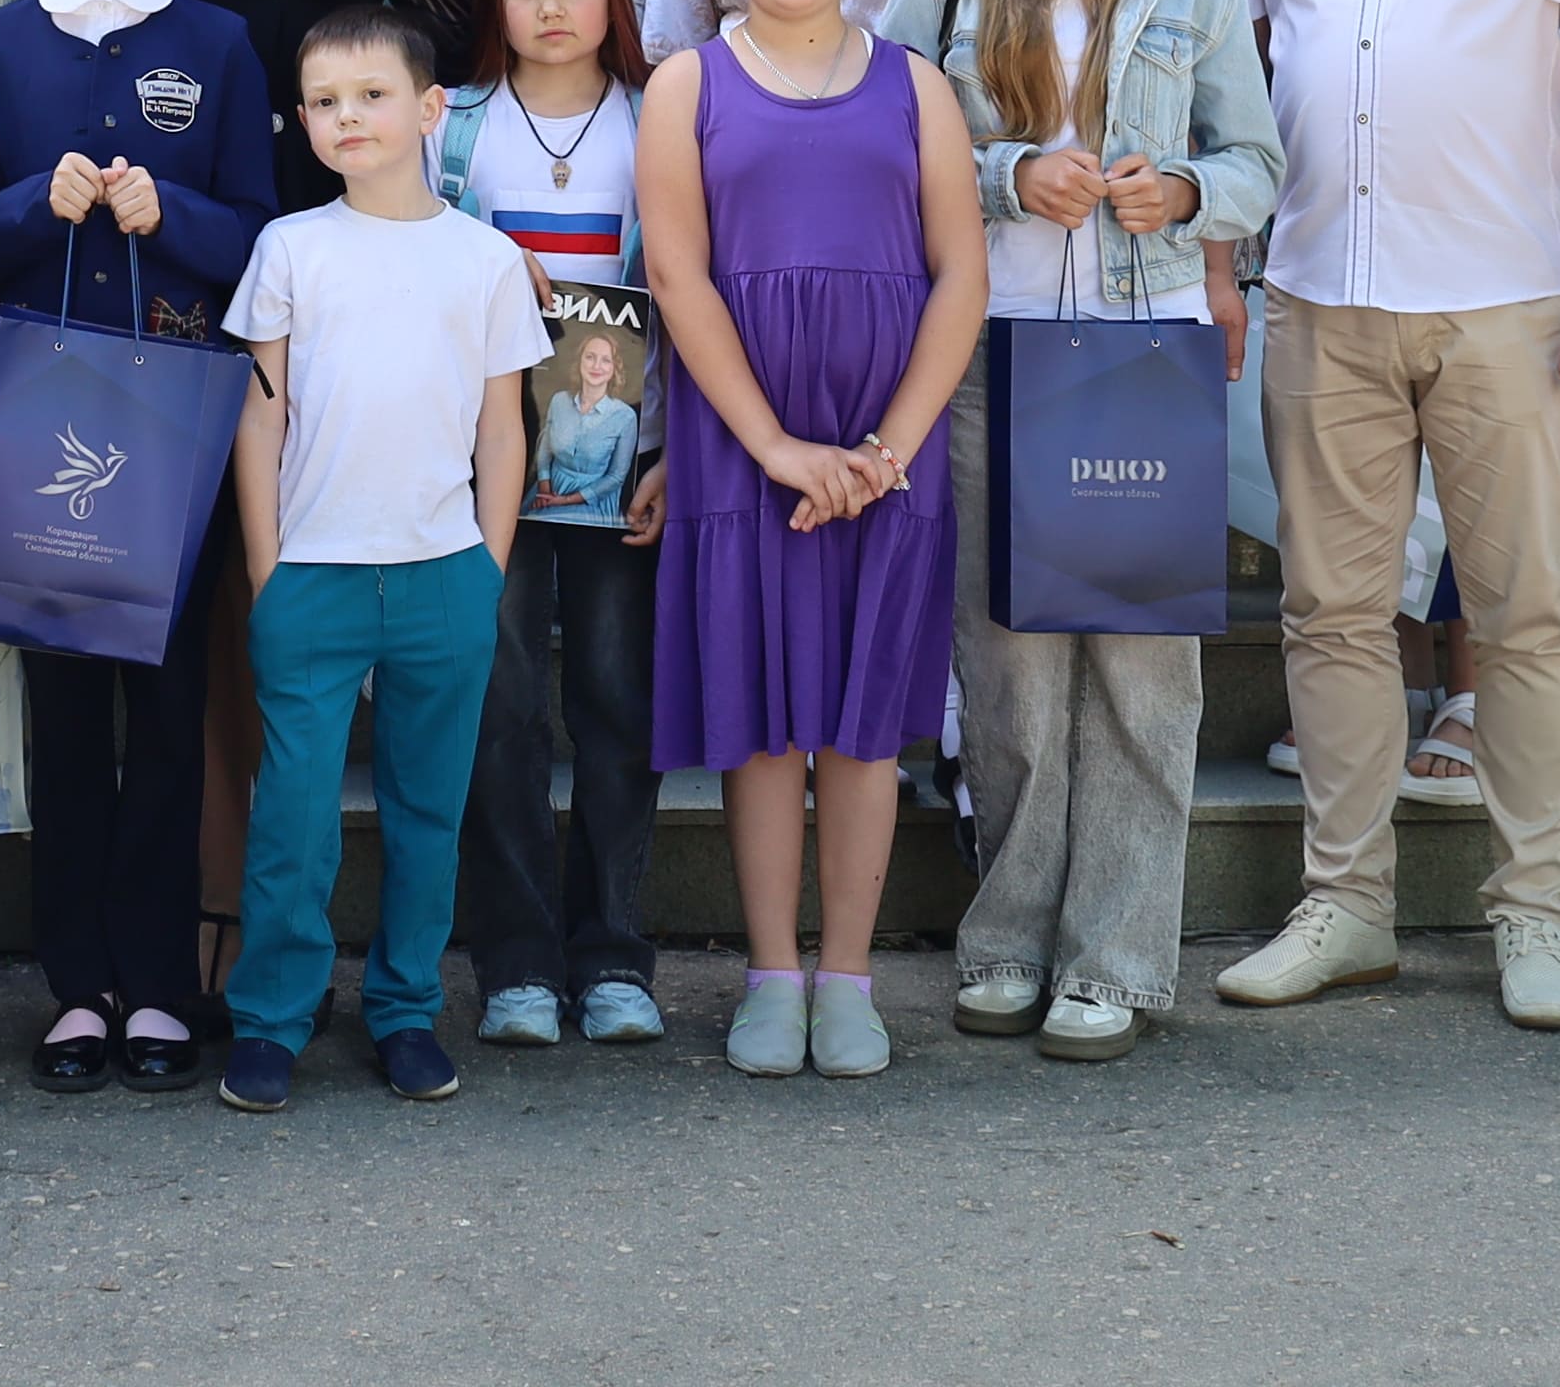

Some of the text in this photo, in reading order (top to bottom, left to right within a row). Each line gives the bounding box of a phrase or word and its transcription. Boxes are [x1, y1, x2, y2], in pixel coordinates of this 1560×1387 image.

[1071, 487, 1161, 499] Смоленская область
[46, 525, 98, 541] Корпорация
[12, 531, 128, 557] инвестиционного развития
[25, 542, 113, 564] Смоленской области
